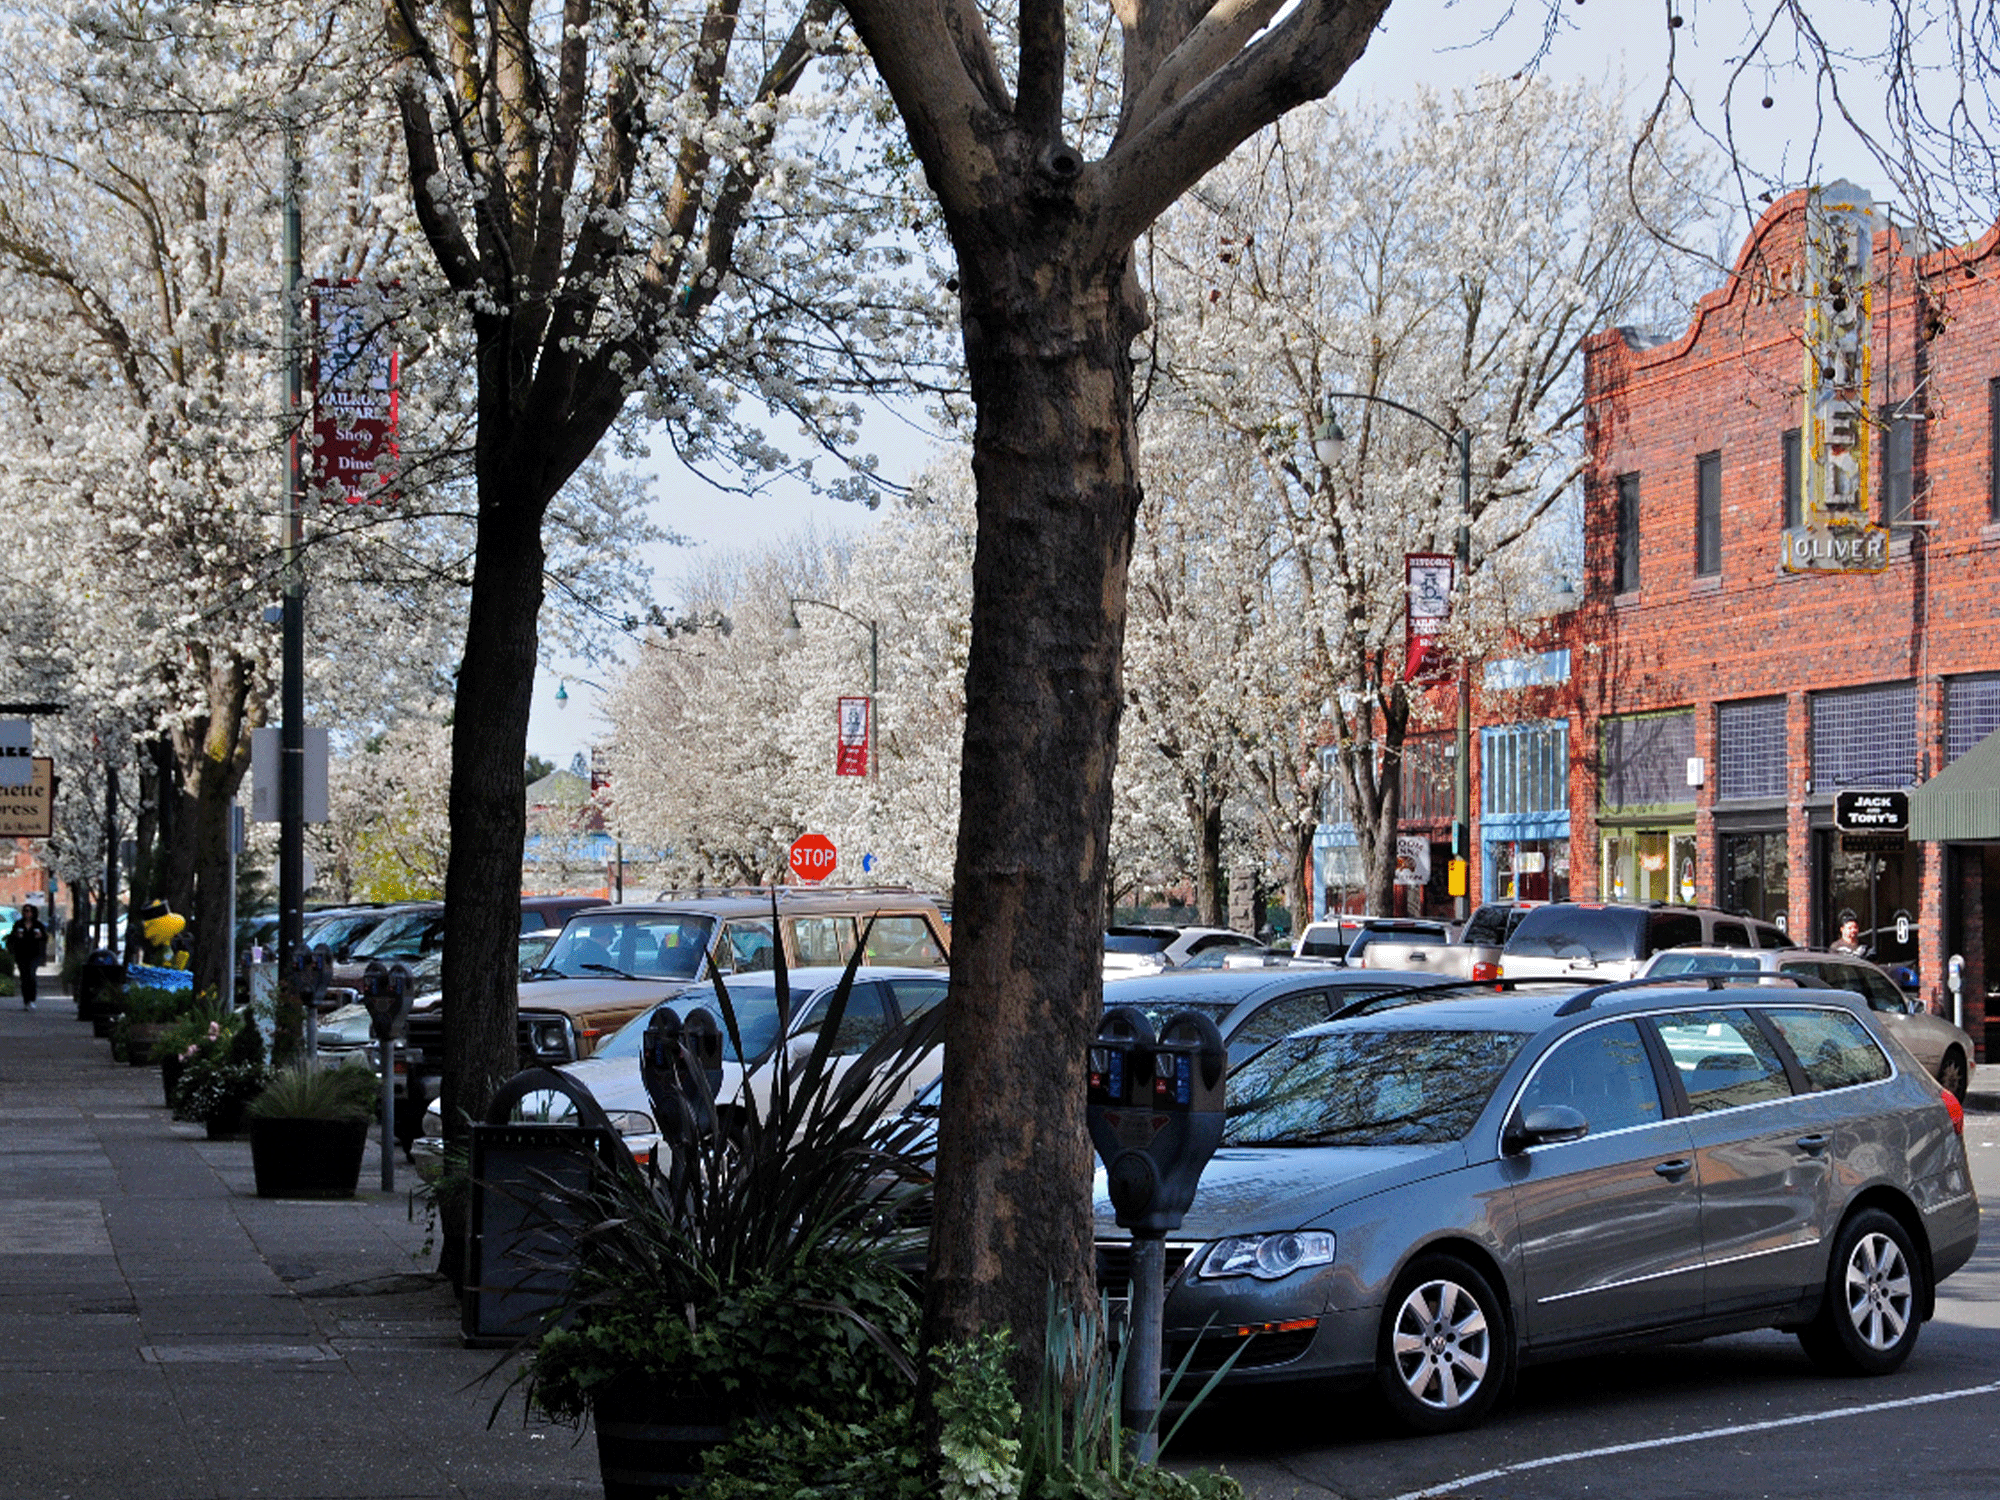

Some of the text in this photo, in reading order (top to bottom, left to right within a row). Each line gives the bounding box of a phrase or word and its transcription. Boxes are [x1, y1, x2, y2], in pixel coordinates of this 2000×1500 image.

[318, 392, 391, 406] AILRO
[338, 456, 373, 470] Dine
[1795, 538, 1881, 559] OLIVER
[0, 784, 44, 798] ette
[1854, 796, 1892, 807] JACK
[0, 804, 38, 816] ress
[1848, 812, 1898, 823] TONY'S
[793, 848, 834, 867] STOP
